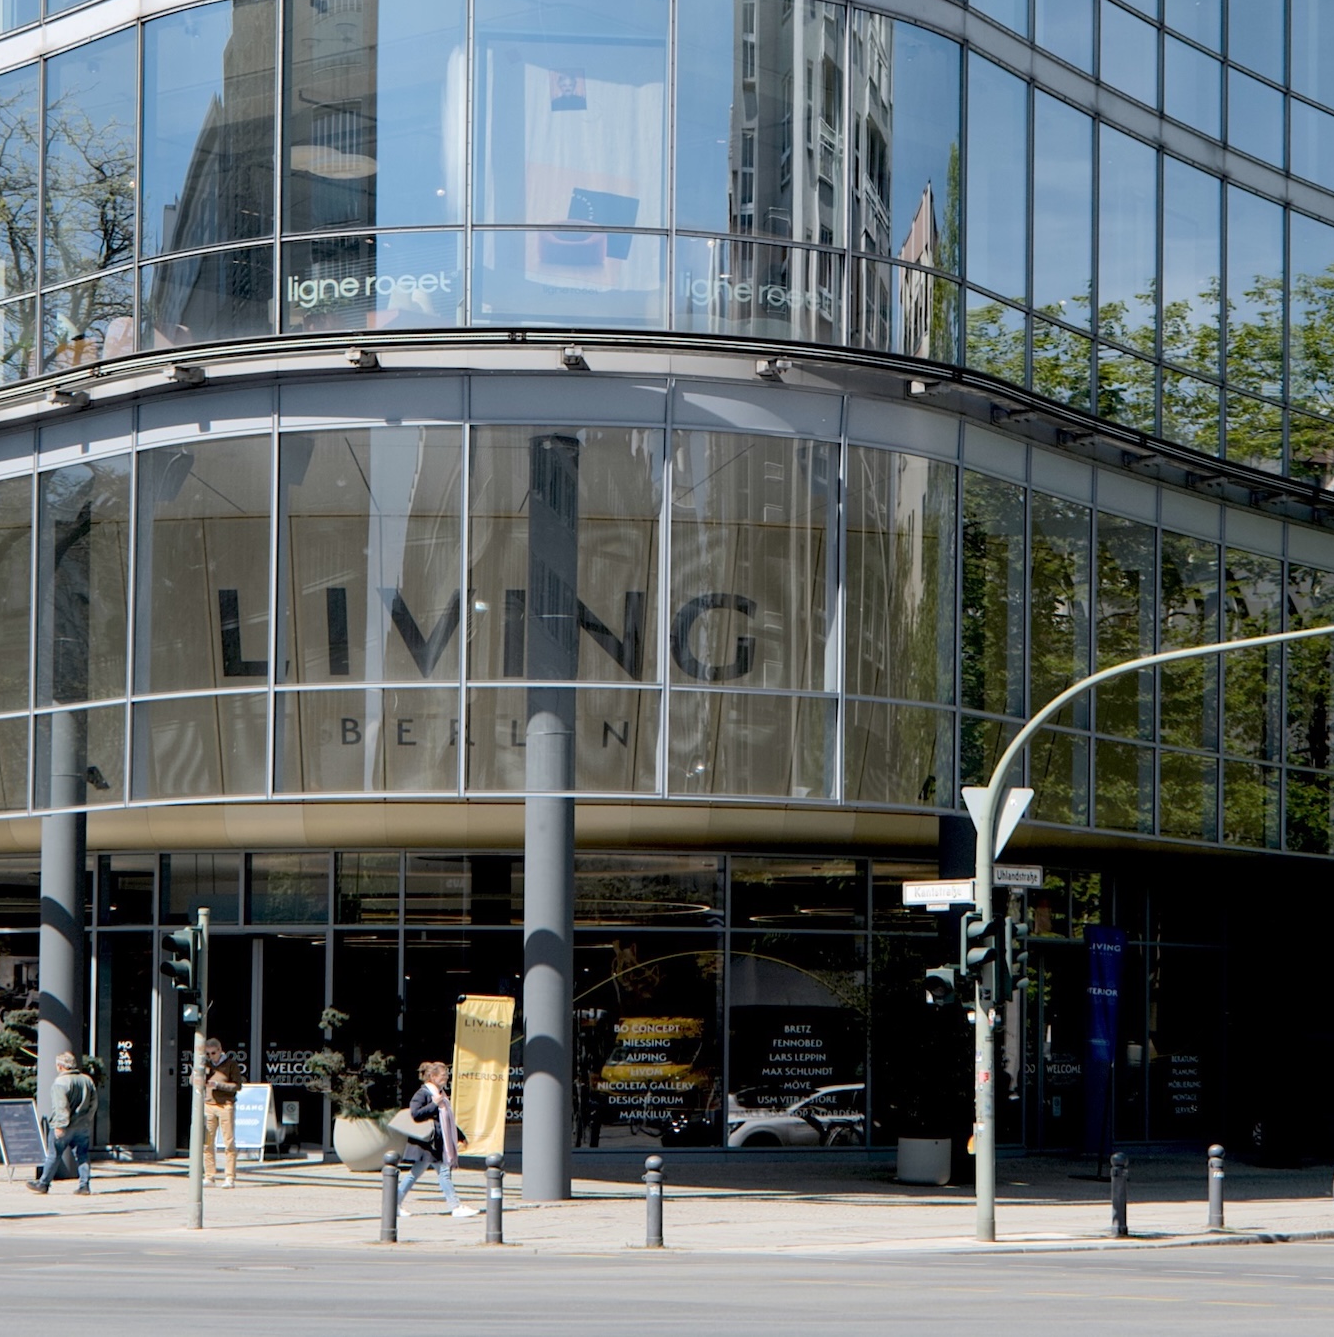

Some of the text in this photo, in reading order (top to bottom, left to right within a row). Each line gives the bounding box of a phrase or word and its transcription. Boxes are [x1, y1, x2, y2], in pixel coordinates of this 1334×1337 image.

[286, 271, 452, 309] ligne roset
[679, 271, 753, 306] ligne
[218, 587, 757, 681] LIVING
[341, 716, 630, 748] BERLN
[1089, 942, 1121, 952] IVING
[1087, 987, 1118, 997] TERIOR
[613, 1024, 680, 1033] BO CONCEPT
[784, 1025, 812, 1033] BRETZ
[117, 1041, 133, 1050] MO
[623, 1039, 671, 1047] NIESSING
[773, 1039, 823, 1047] FENNOBED
[266, 1050, 316, 1061] WELCO
[626, 1053, 667, 1062] AUPING
[769, 1053, 826, 1061] LARS LEPPIN
[266, 1064, 313, 1074] WELCO
[762, 1067, 833, 1075] MAX SCHLUNDT
[1046, 1064, 1082, 1074] WELCOME
[458, 1072, 505, 1082] INTERIOR
[597, 1082, 695, 1090] NICOLETA GALLERY
[757, 1095, 778, 1104] USM
[619, 1110, 673, 1119] MARKILUX
